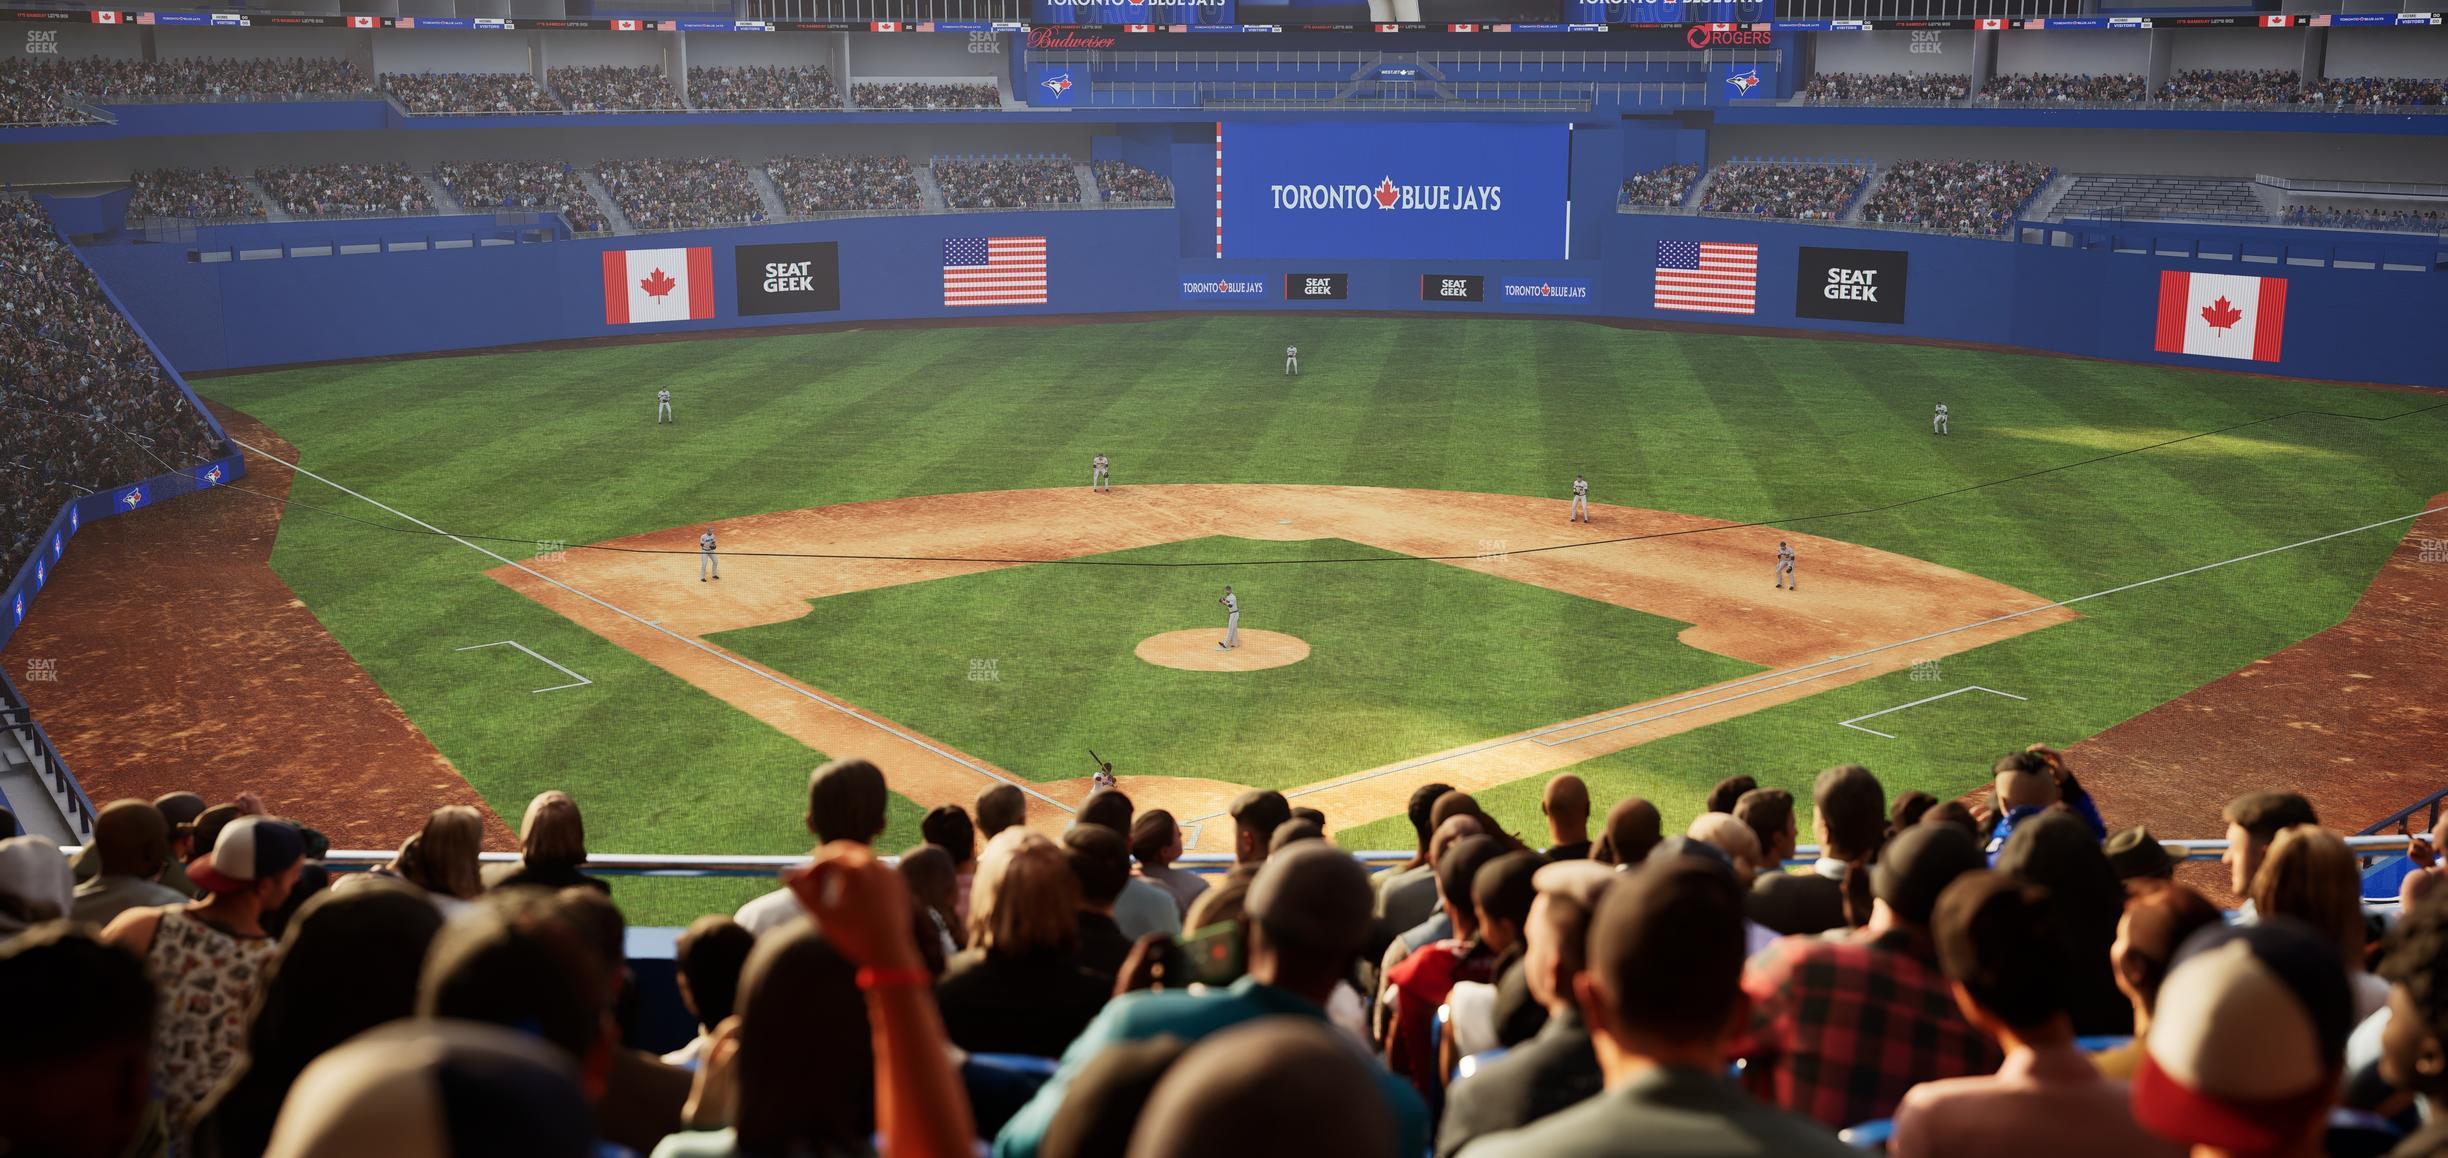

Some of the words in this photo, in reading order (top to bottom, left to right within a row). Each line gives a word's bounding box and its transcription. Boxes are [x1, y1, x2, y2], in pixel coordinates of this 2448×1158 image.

[1027, 26, 1115, 48] Budweiser
[1712, 32, 1771, 44] ROGERS
[1271, 184, 1372, 209] TORONTO
[1402, 185, 1450, 210] BLUE
[1453, 186, 1501, 211] JAYS
[766, 261, 811, 277] SEAT
[1306, 278, 1330, 287] SEAT
[1828, 268, 1877, 285] SEAT
[763, 277, 814, 292] GEEK
[1183, 282, 1218, 292] TORONTO
[1228, 282, 1245, 292] BLUE
[1246, 282, 1263, 293] JAYS
[1442, 279, 1466, 288] SEAT
[1304, 286, 1331, 295] GEEK
[1440, 288, 1467, 297] GEEK
[1505, 285, 1540, 296] TORONTO
[1551, 286, 1568, 297] BLUE
[1569, 287, 1586, 297] JAYS
[1824, 284, 1878, 302] GEEK
